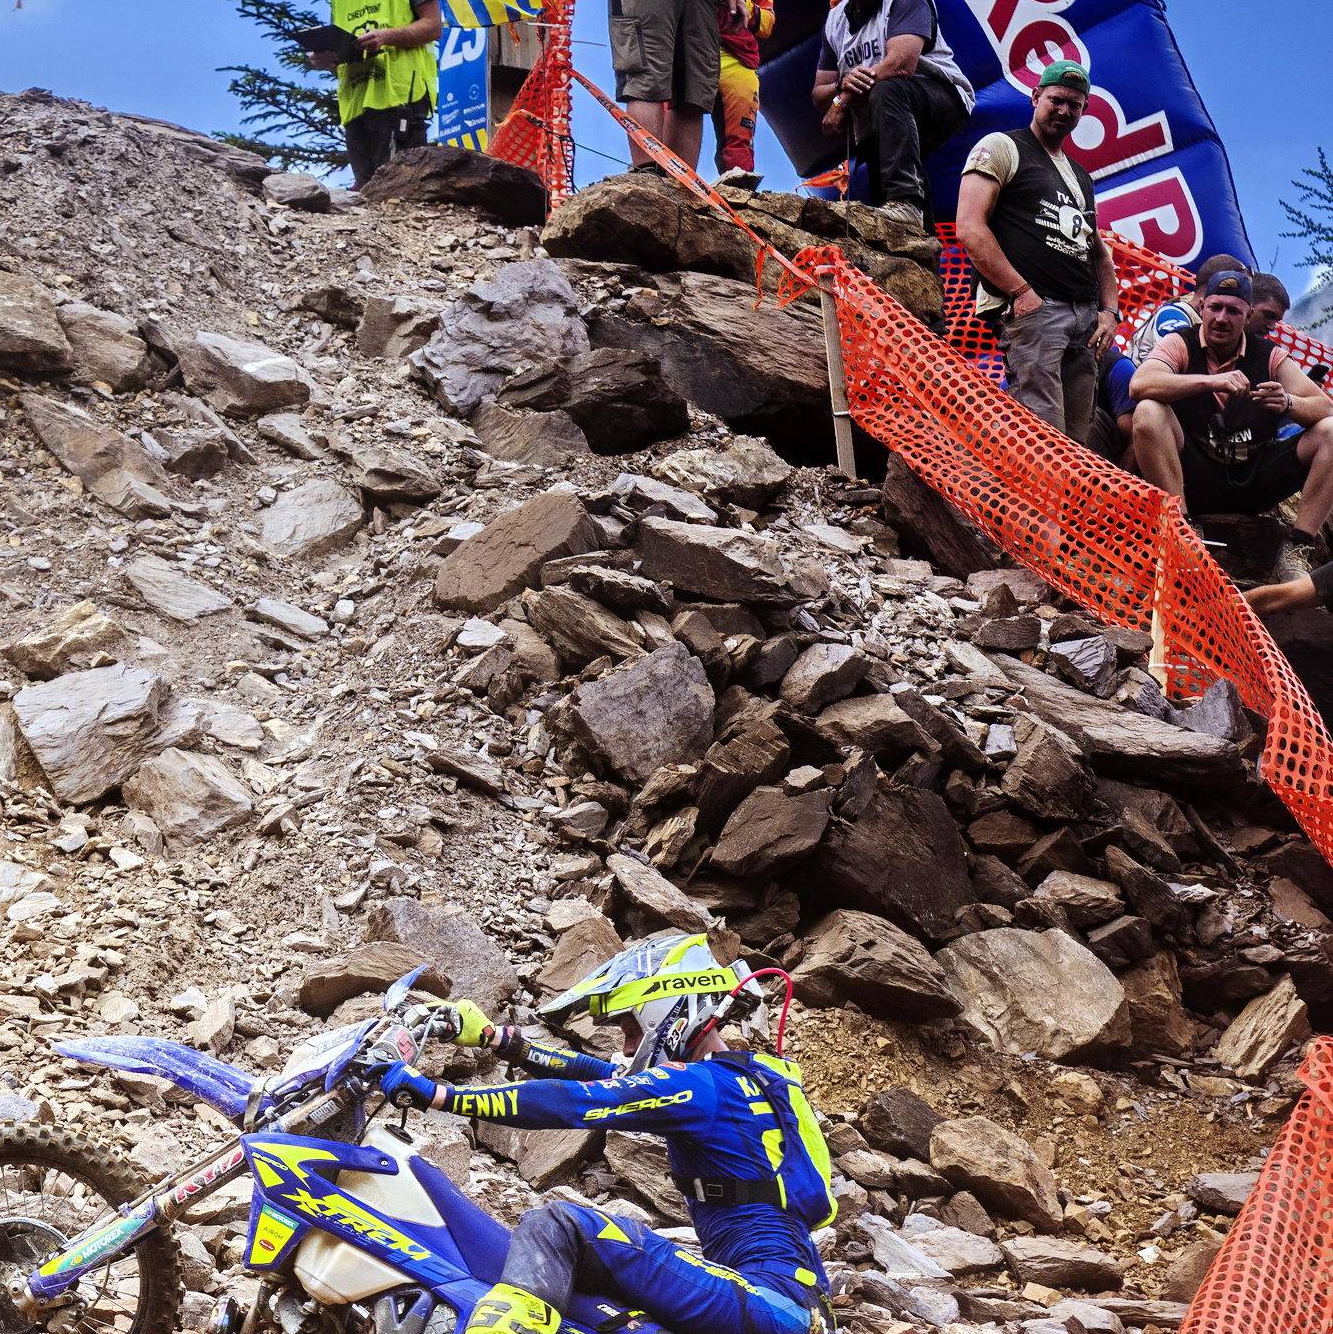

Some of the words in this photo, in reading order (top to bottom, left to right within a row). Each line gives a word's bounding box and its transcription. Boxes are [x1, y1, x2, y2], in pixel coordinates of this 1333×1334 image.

[662, 973, 727, 992] raven
[666, 1028, 682, 1051] 23
[583, 1090, 694, 1121] SHERCO
[270, 1210, 296, 1228] MOTOREX
[81, 1225, 125, 1260] MOTOREX
[262, 1226, 284, 1240] AIROH
